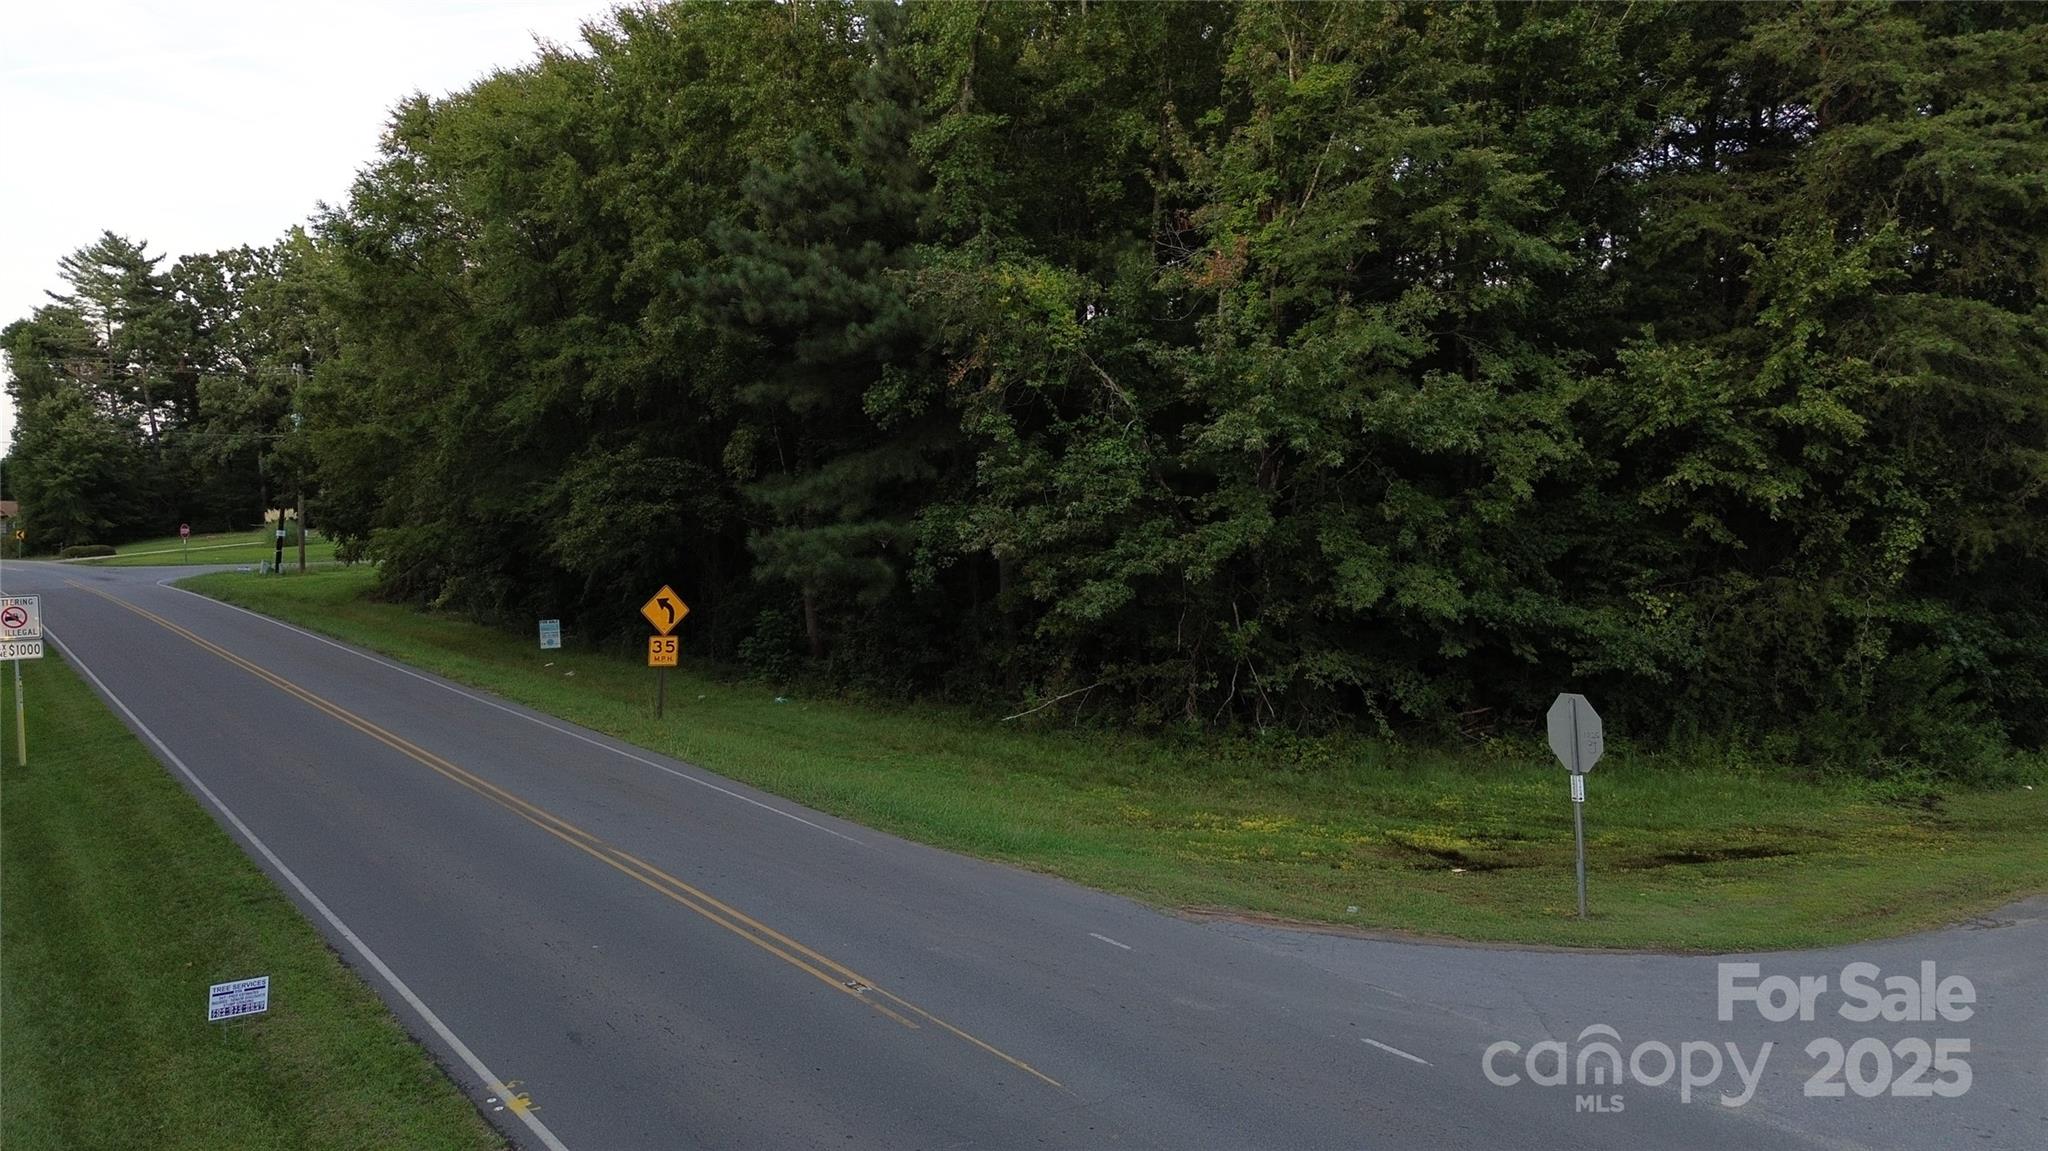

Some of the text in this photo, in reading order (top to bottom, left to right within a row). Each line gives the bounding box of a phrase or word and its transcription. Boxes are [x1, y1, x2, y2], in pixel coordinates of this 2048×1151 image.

[5, 628, 38, 636] ILLEGAL
[9, 644, 41, 656] $1000
[652, 640, 675, 654] 35
[213, 985, 230, 993] TREE
[232, 980, 266, 989] SERVICES
